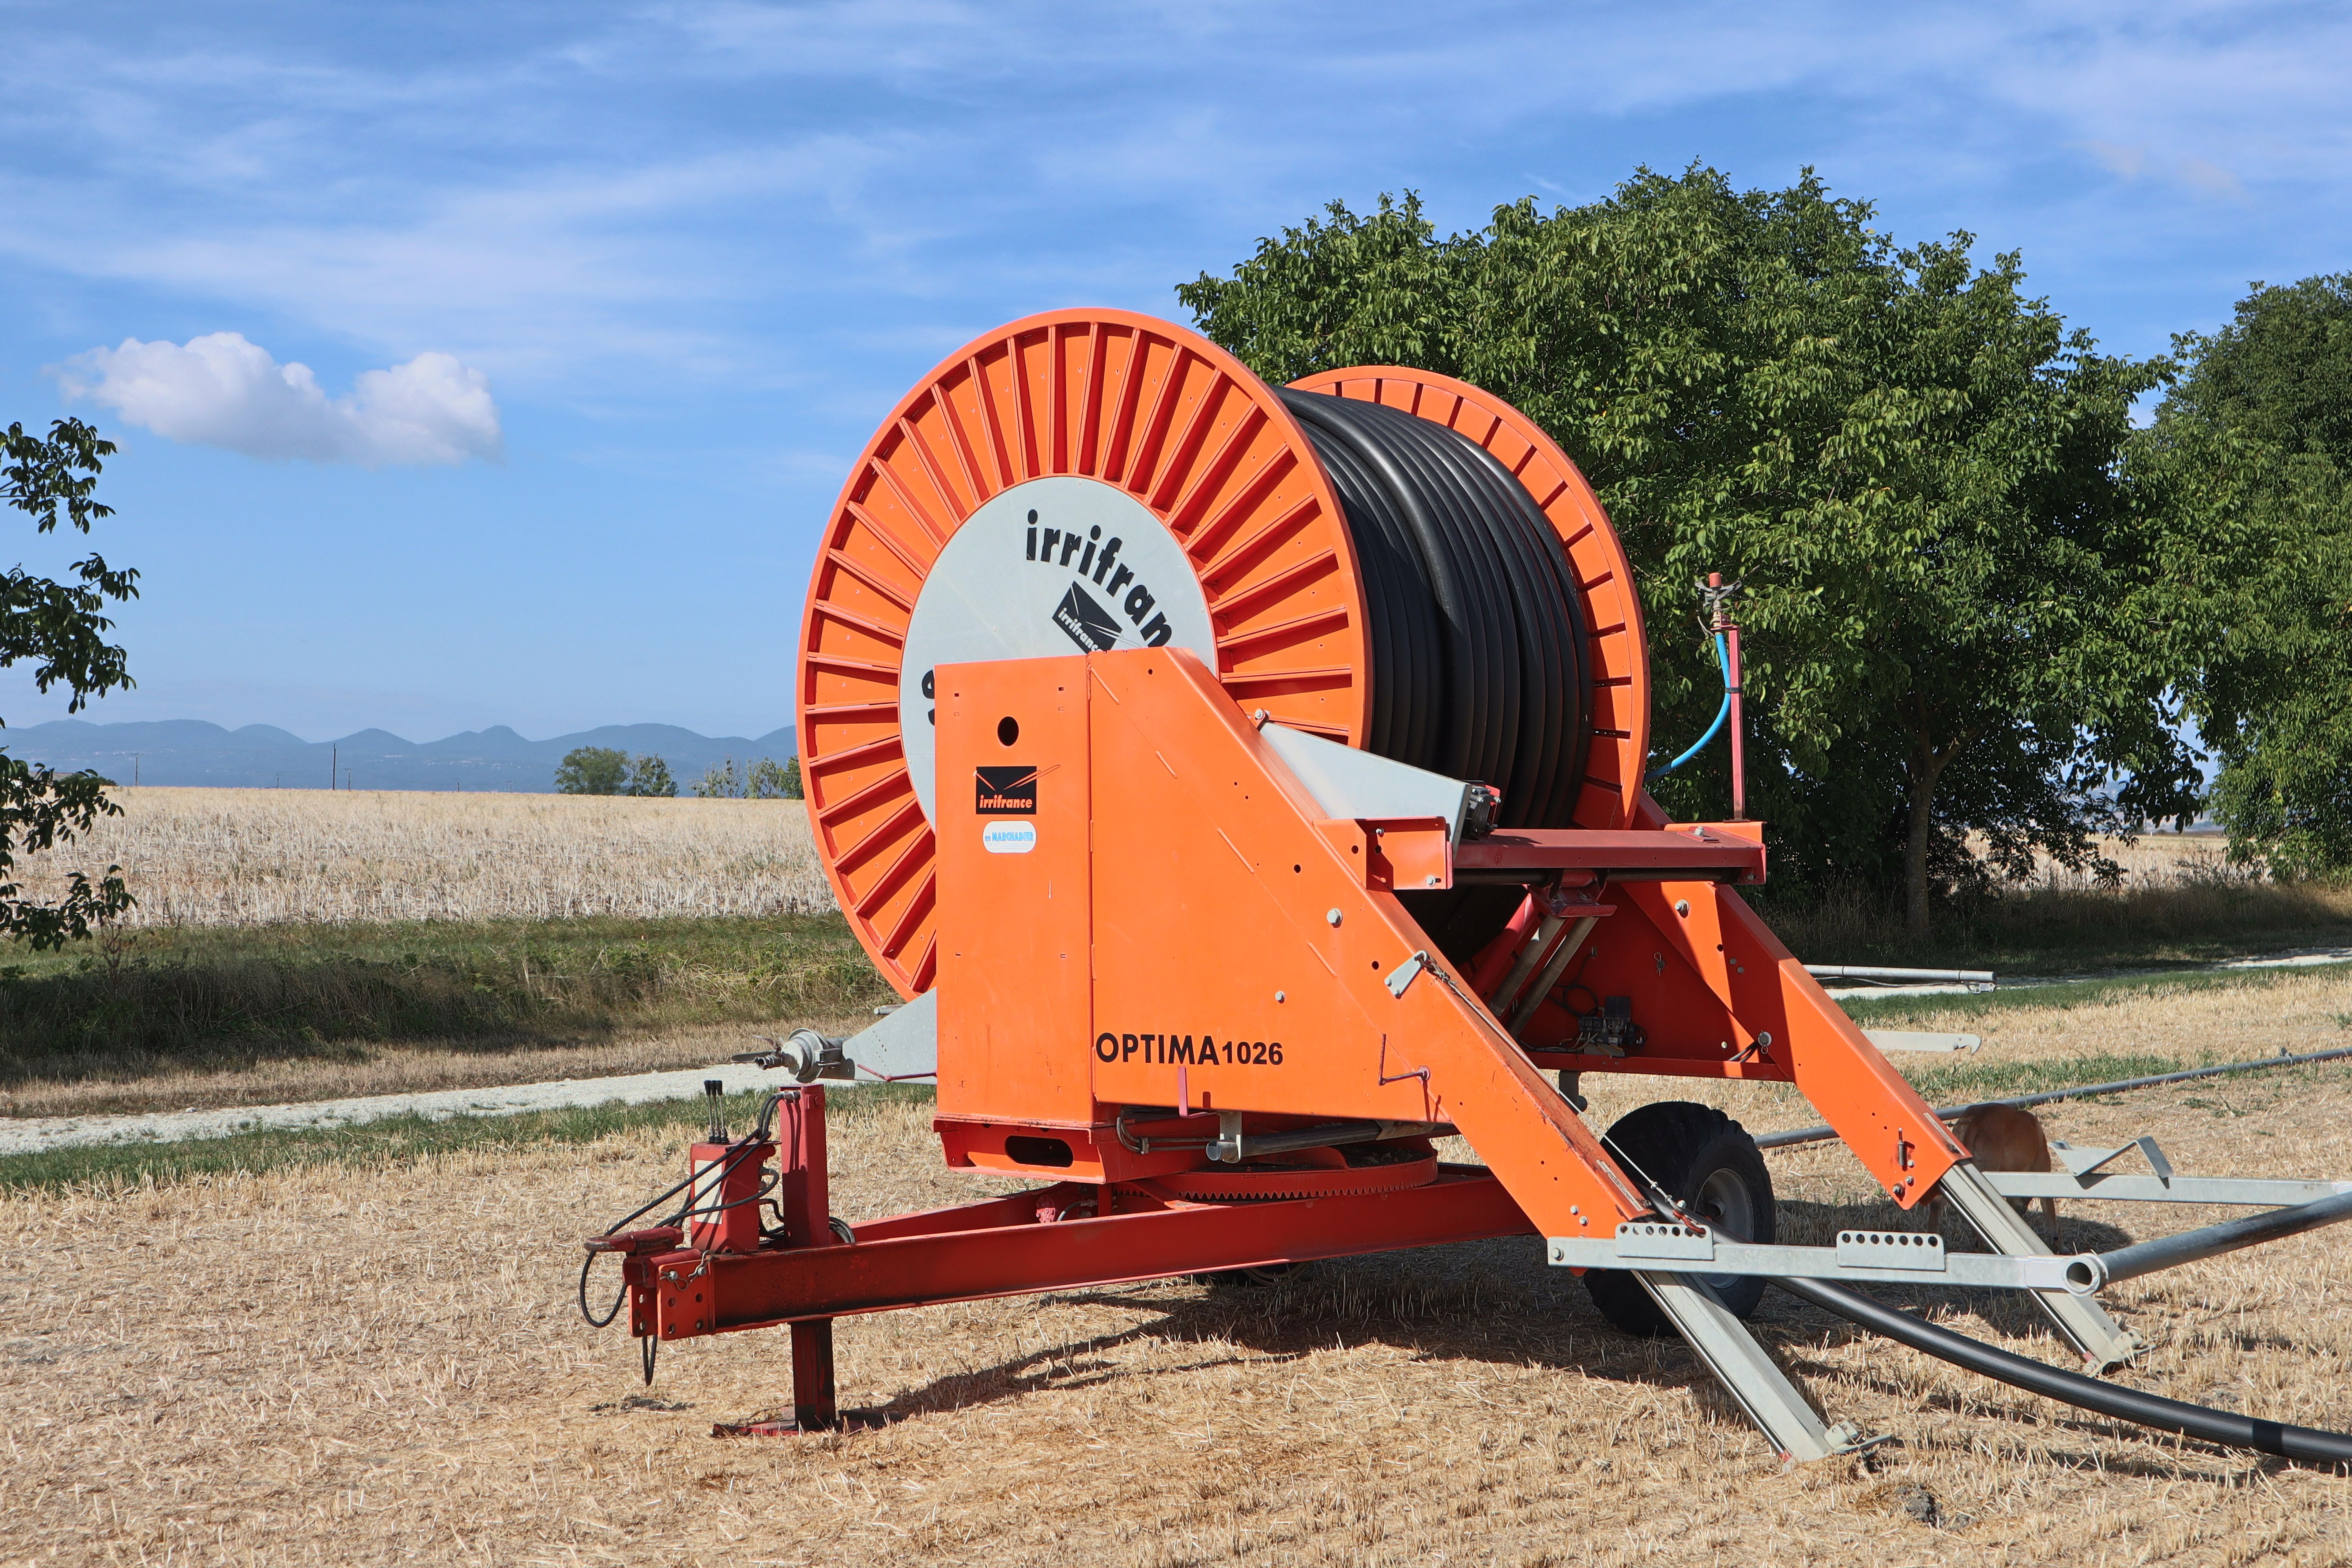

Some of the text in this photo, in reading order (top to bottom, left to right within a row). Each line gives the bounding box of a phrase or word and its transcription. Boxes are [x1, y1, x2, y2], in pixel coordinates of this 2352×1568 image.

[1058, 607, 1103, 652] irrifranc
[980, 795, 1033, 808] irrifrance
[1096, 1033, 1283, 1065] OPTIMA 1026
